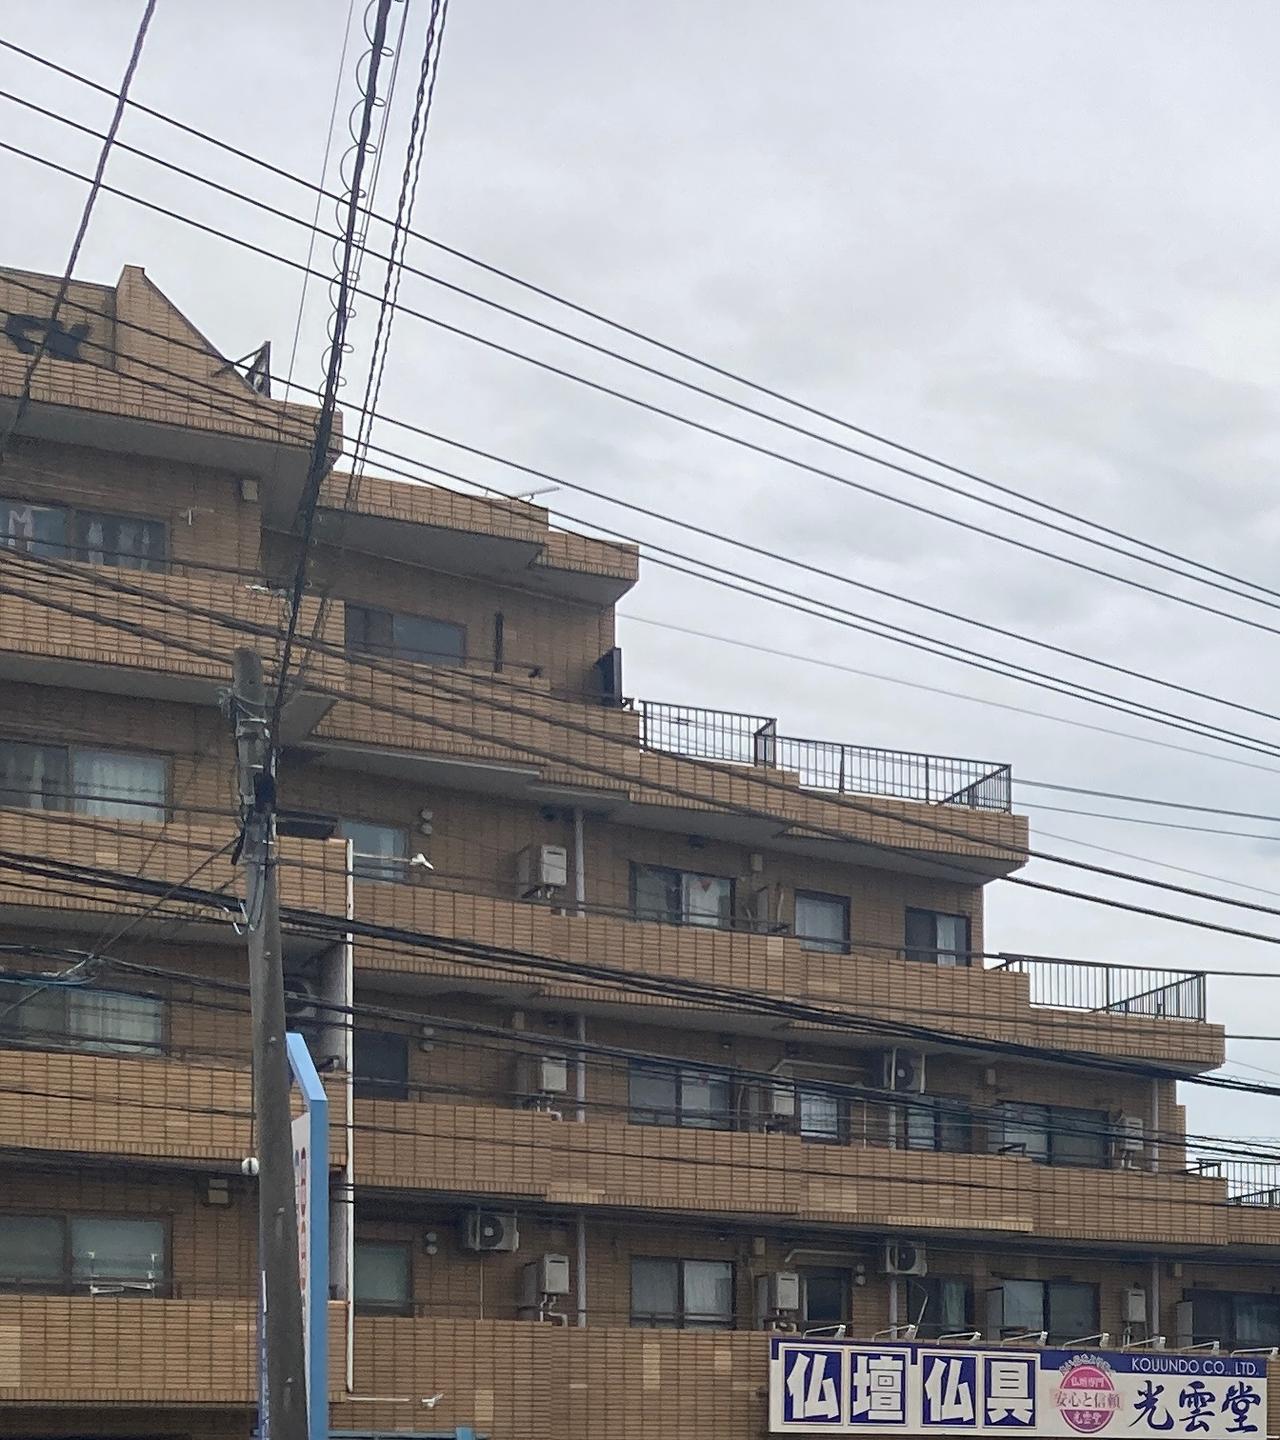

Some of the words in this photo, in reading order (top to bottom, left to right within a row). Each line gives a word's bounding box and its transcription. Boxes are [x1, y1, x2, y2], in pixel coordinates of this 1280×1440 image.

[1131, 1357, 1200, 1374] KOUUNDO
[786, 1352, 1034, 1425] 仏壇仏具
[1056, 1390, 1121, 1409] 安心と信頼
[1128, 1380, 1261, 1434] 光雲堂
